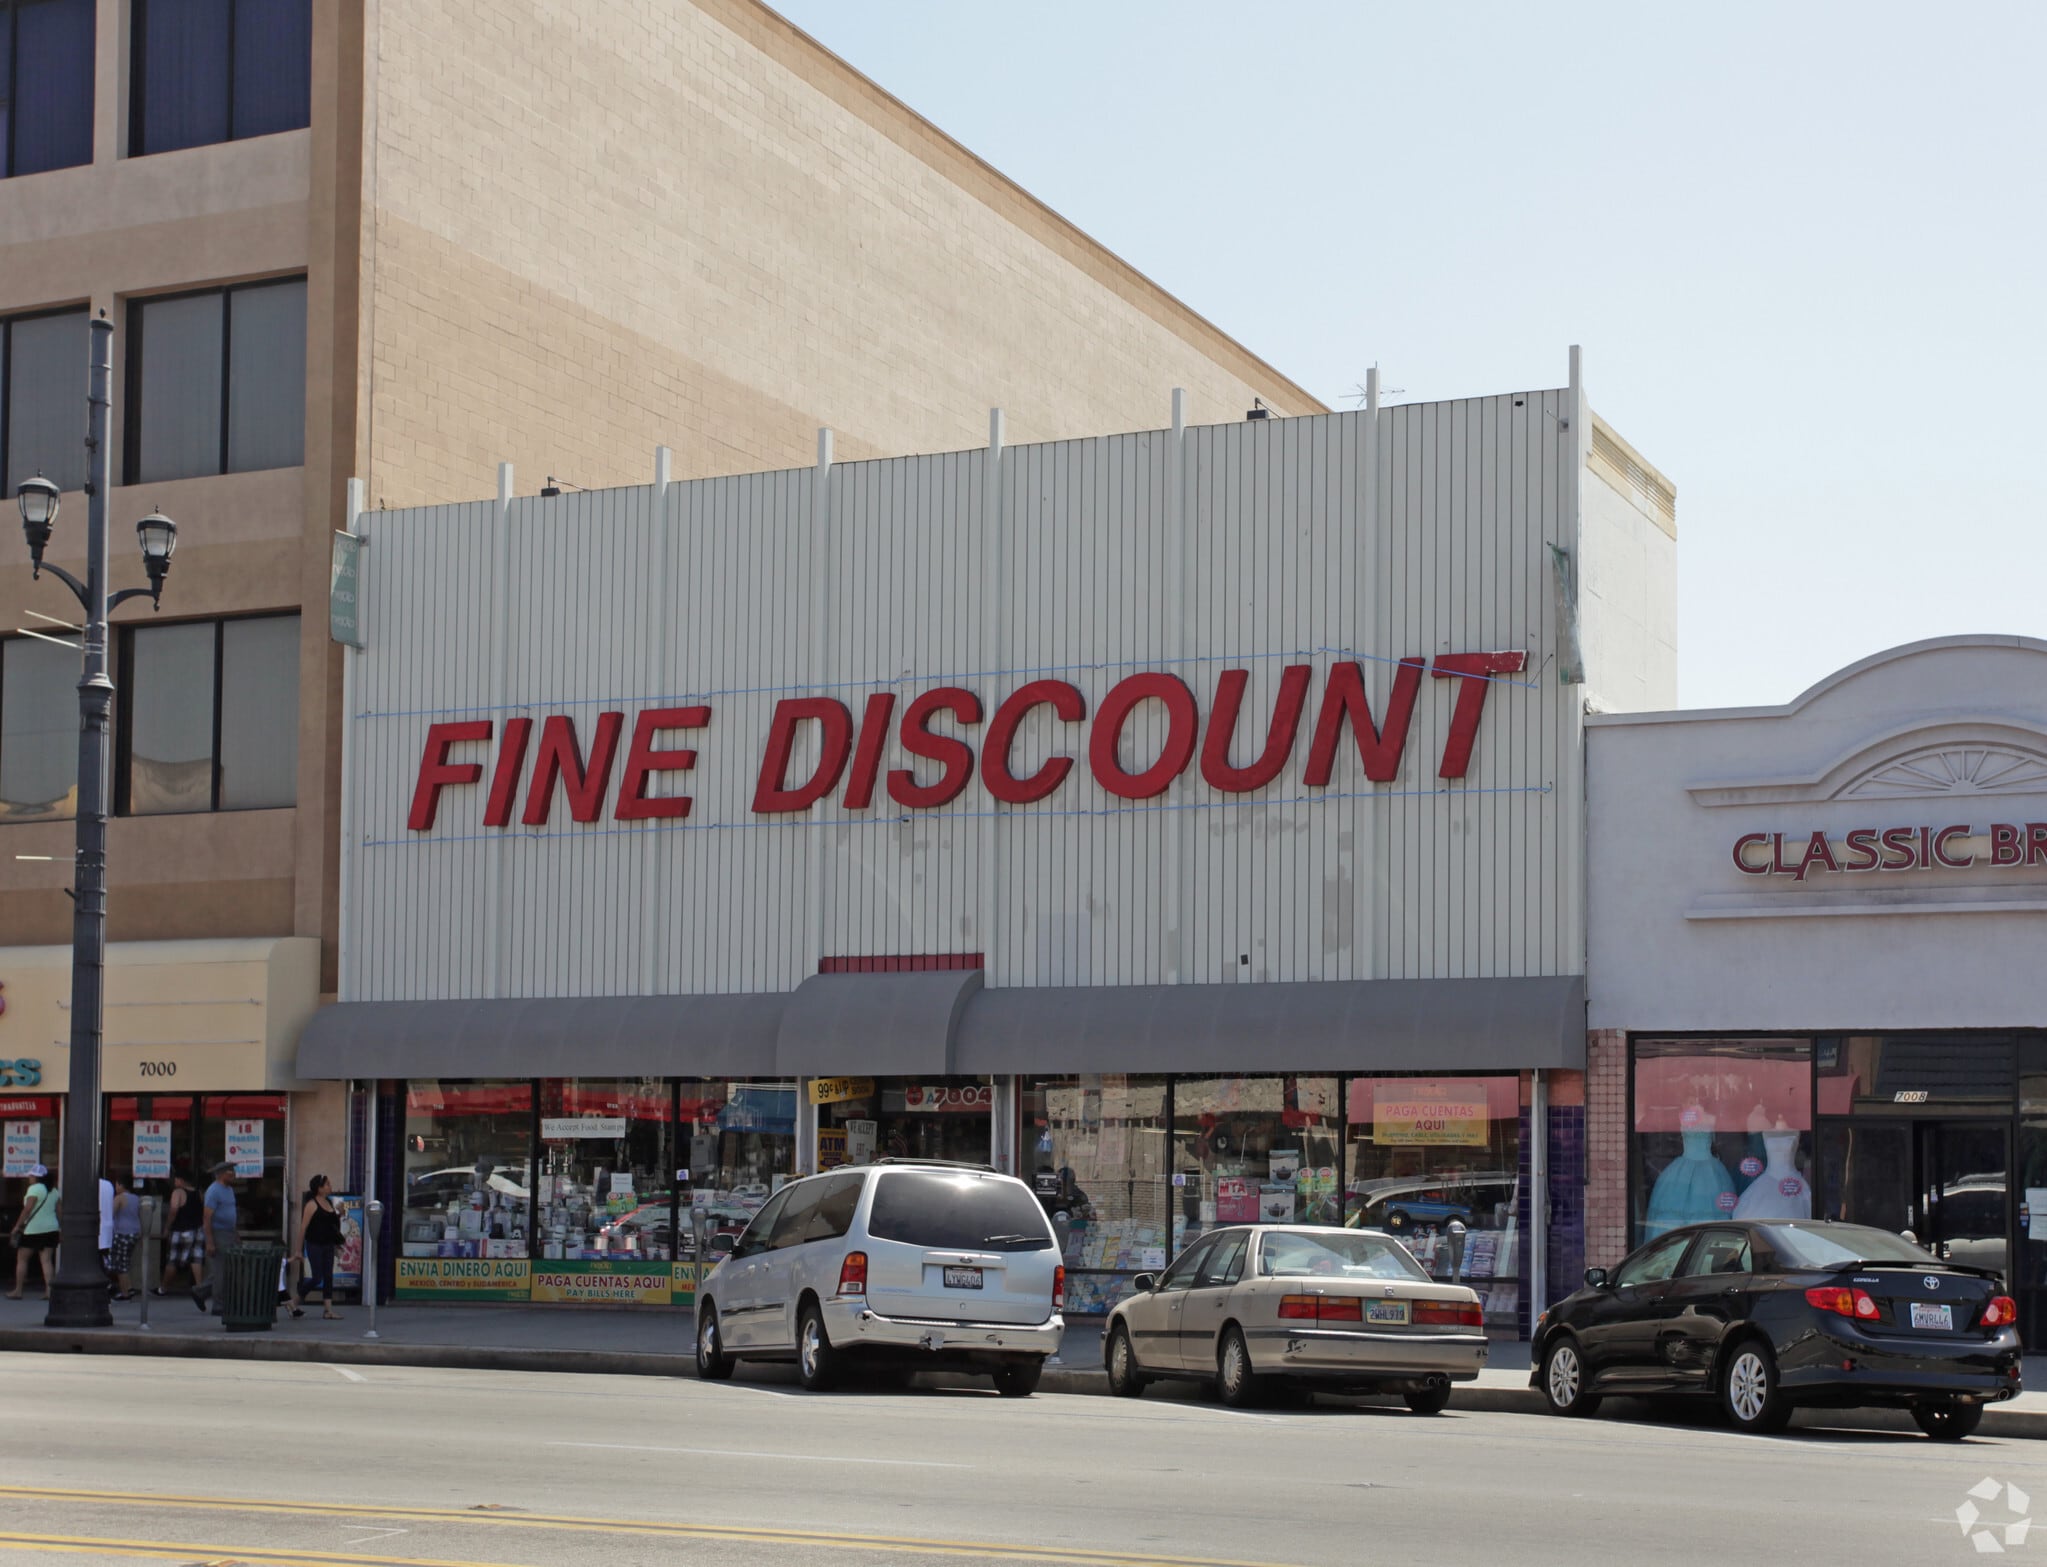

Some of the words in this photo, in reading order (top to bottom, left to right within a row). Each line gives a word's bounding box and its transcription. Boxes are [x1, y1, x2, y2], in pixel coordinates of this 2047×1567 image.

[407, 705, 711, 831] FINE
[752, 649, 1529, 813] DISCOUNT
[1732, 826, 1974, 882] CLASSIC
[139, 1061, 177, 1077] 7000
[934, 1085, 993, 1106] 7004
[1894, 1091, 1927, 1103] 7008
[1386, 1104, 1418, 1117] PAGA
[1422, 1104, 1474, 1117] CUENTAS
[544, 1123, 555, 1132] We
[557, 1123, 580, 1133] Accept
[581, 1122, 598, 1132] Food
[600, 1122, 625, 1133] Stamps
[1415, 1119, 1445, 1131] AQUI
[820, 1137, 846, 1151] ATM
[400, 1262, 439, 1277] ENVIA
[443, 1262, 491, 1277] DINERO
[494, 1262, 527, 1278] AQUI
[674, 1265, 711, 1281] ENVA
[537, 1274, 571, 1287] PAGA
[575, 1274, 629, 1288] CUENTAS
[633, 1276, 665, 1289] AQUI
[566, 1288, 585, 1297] PAY
[587, 1288, 610, 1298] BILLS
[613, 1289, 636, 1299] HERE
